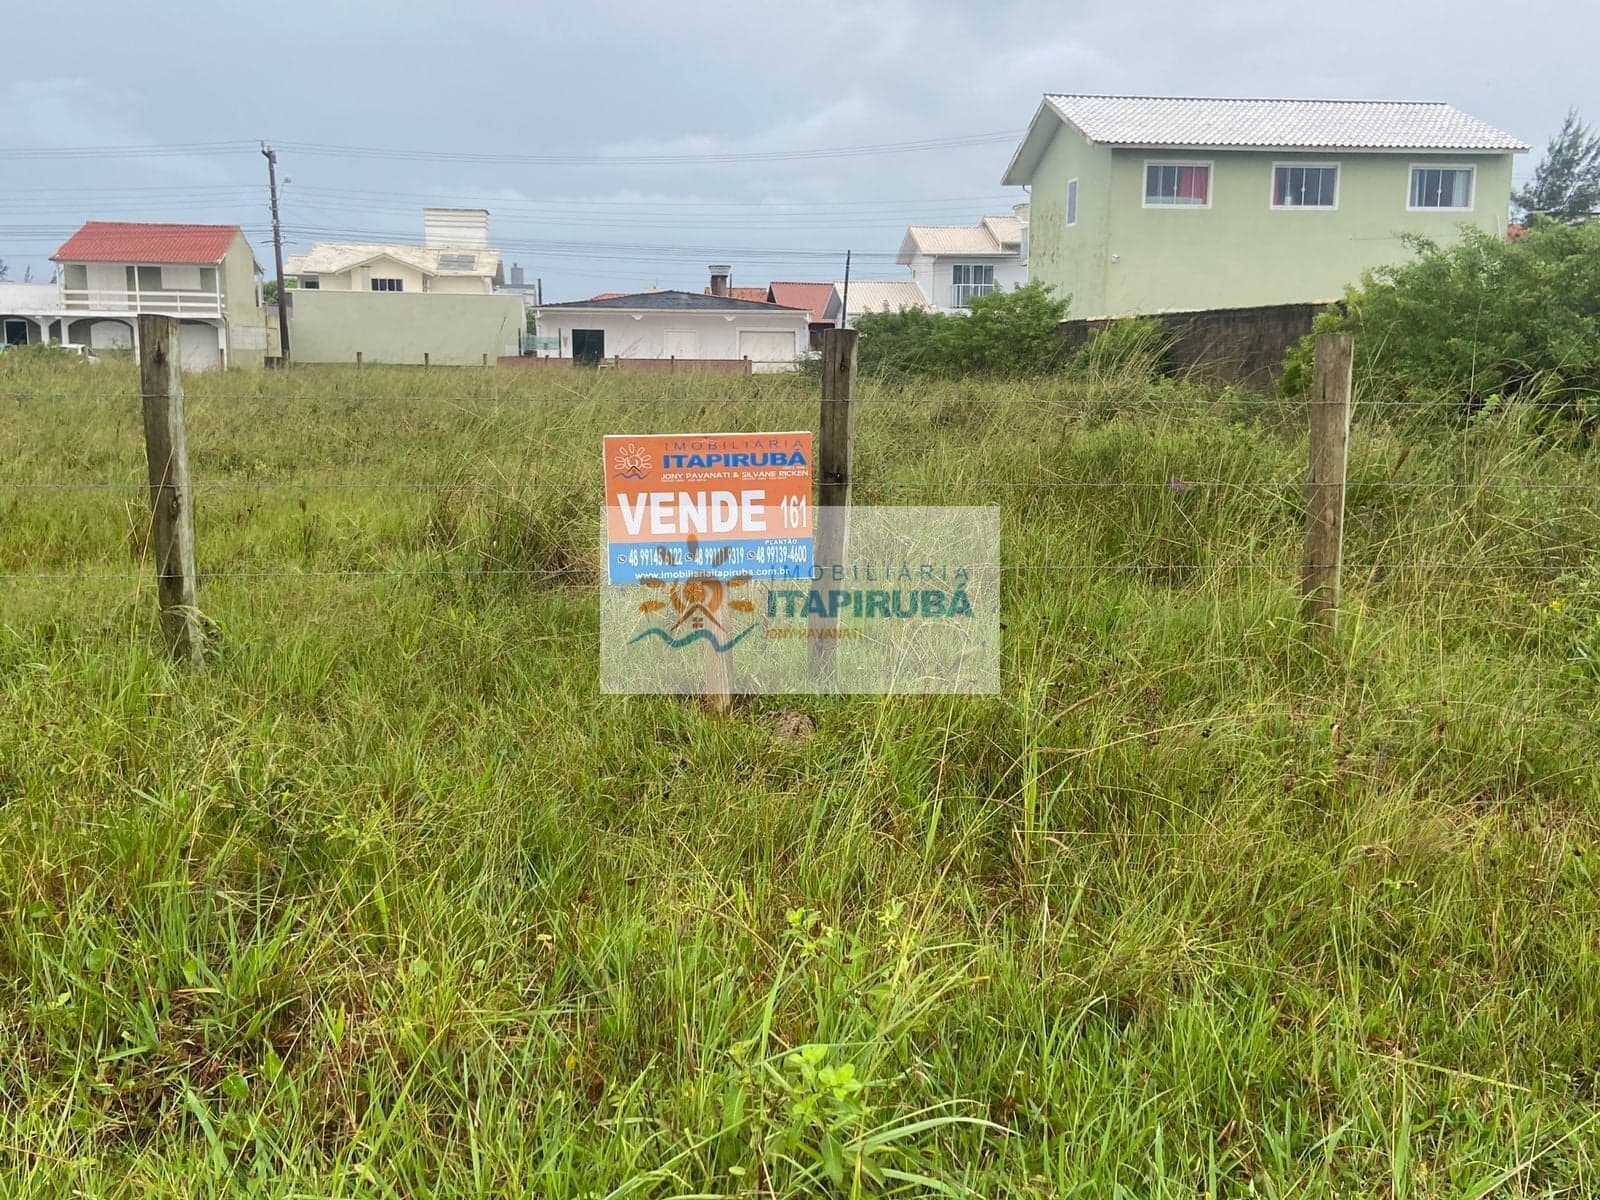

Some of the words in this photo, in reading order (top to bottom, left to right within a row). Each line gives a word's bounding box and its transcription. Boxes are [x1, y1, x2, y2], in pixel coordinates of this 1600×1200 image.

[663, 449, 806, 469] ITAPIRUBÁ
[661, 472, 684, 480] JONY
[686, 471, 730, 479] PAVANATI
[742, 470, 776, 479] SILVANE
[778, 469, 808, 477] RICKEN
[617, 490, 767, 535] VENDE
[781, 495, 807, 529] 161
[628, 548, 639, 567] 48
[695, 547, 703, 566] 48
[756, 545, 765, 564] 48
[766, 544, 807, 564] 99139-4600
